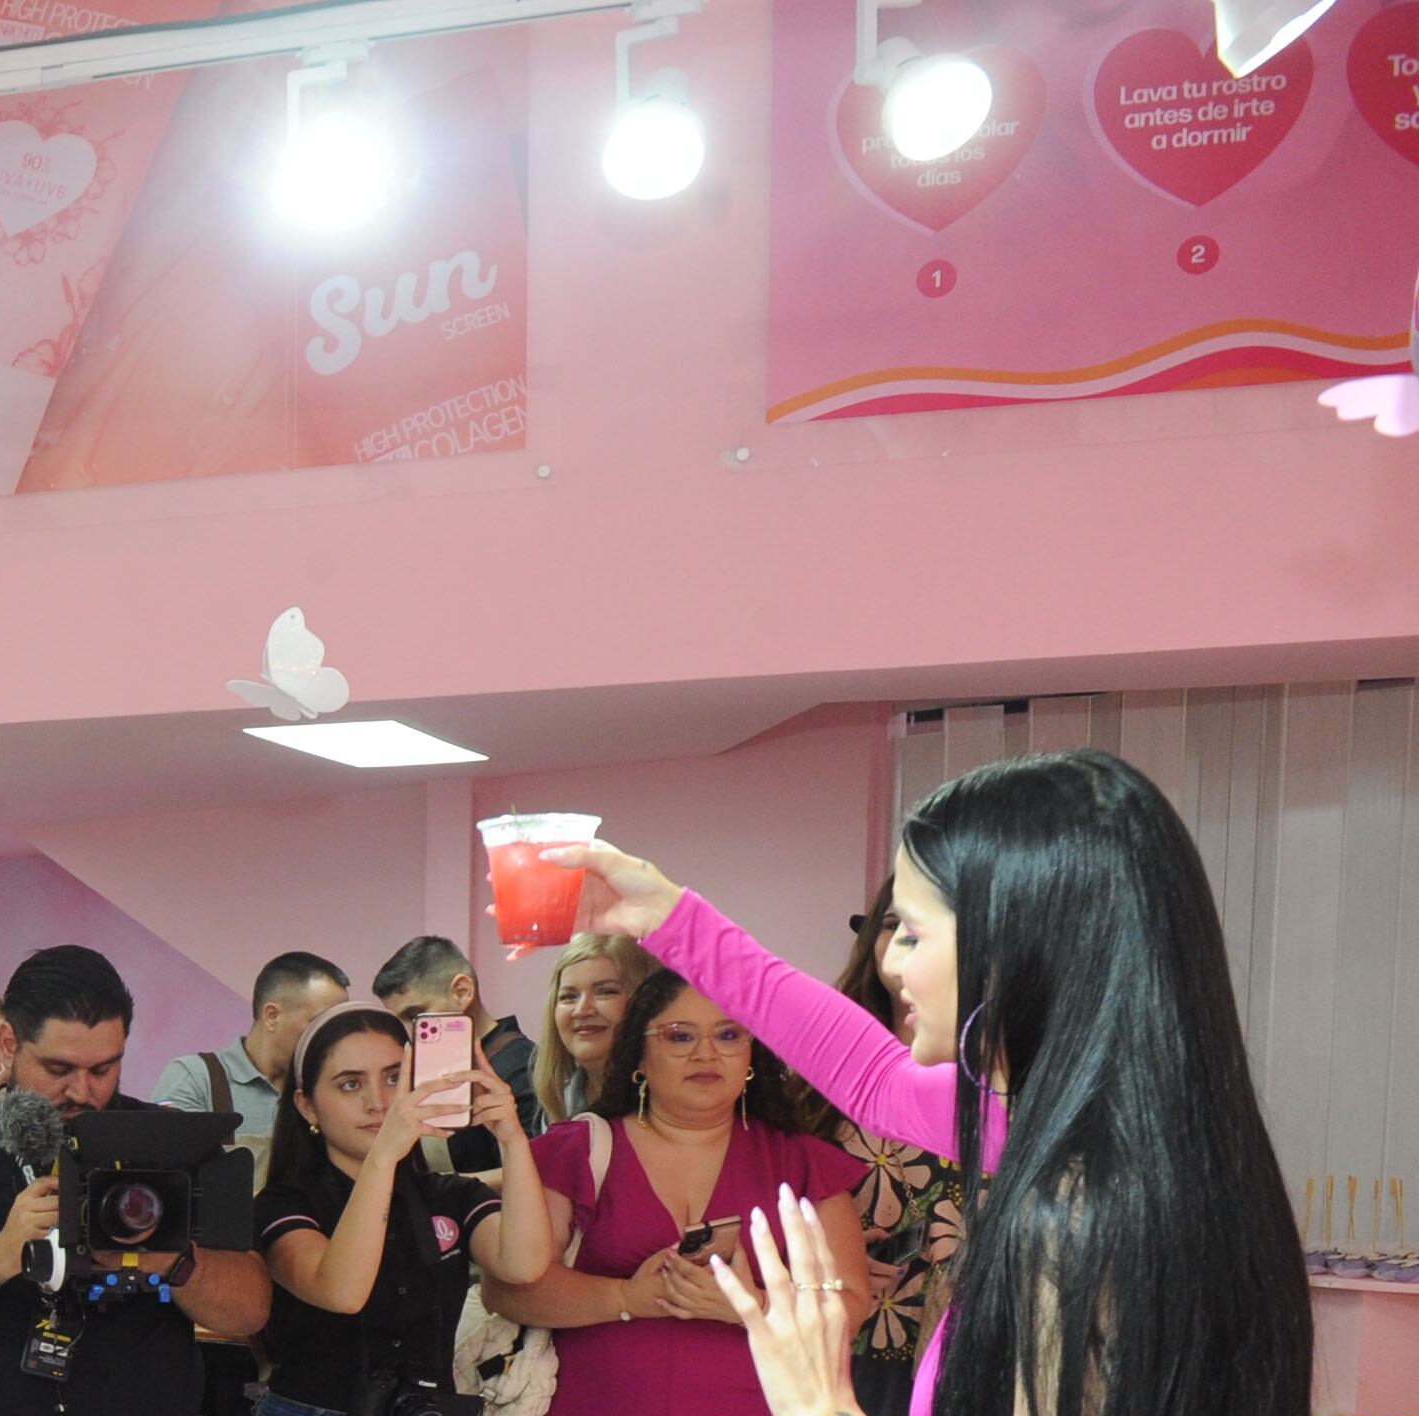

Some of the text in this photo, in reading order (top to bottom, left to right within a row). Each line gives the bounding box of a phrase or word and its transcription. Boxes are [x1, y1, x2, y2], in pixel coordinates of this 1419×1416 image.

[1119, 72, 1288, 105] Lava tu rostro
[1124, 97, 1276, 129] antes de irte
[976, 120, 1020, 138] olar
[1151, 122, 1253, 150] a dormir
[917, 168, 962, 187] días
[1191, 245, 1206, 264] 2
[931, 269, 942, 288] 1
[305, 250, 498, 376] Sun
[441, 300, 511, 341] SCREEN
[353, 374, 527, 464] HIGH PROTECTION
